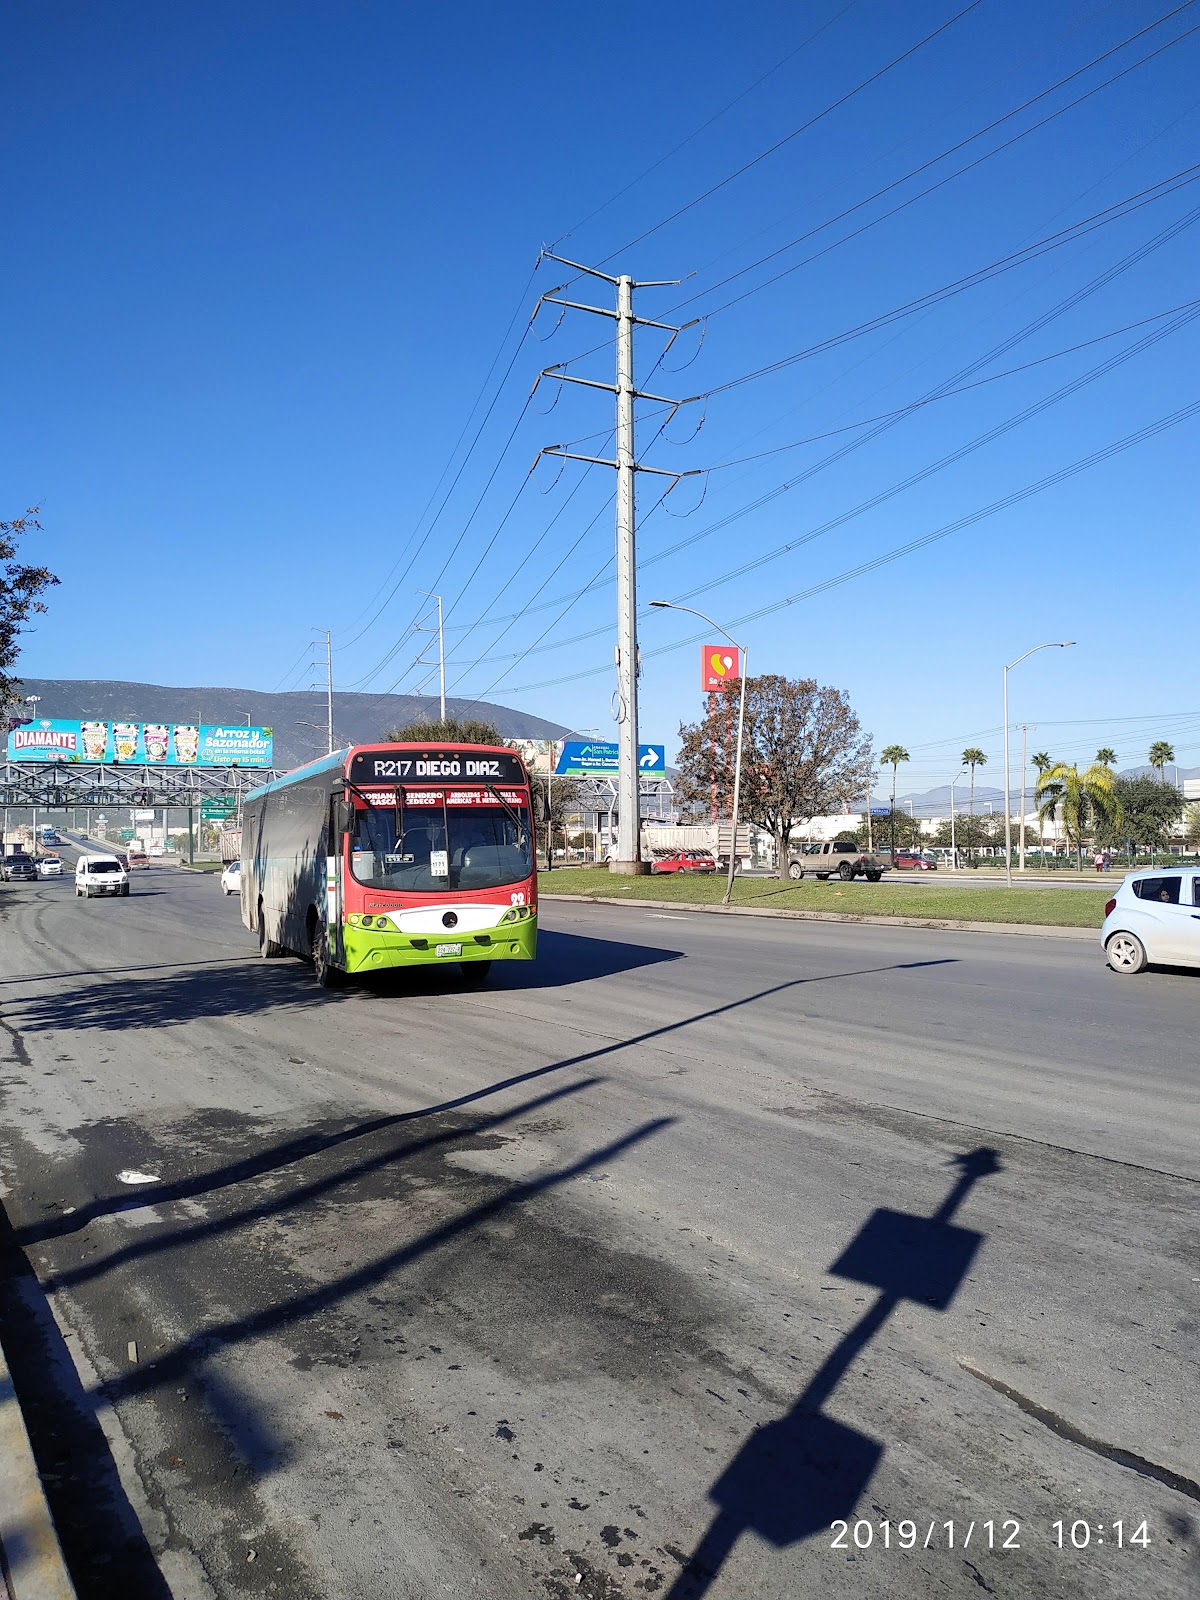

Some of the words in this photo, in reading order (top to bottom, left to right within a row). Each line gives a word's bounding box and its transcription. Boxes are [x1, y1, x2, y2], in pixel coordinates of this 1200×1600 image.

[15, 731, 76, 750] DIAMANTE
[215, 728, 249, 739] Arroz
[252, 730, 260, 740] y
[205, 737, 270, 749] Sazonador
[374, 760, 412, 776] R217
[416, 760, 461, 776] DIEGO
[465, 760, 500, 776] DIAZ
[510, 892, 525, 906] 22
